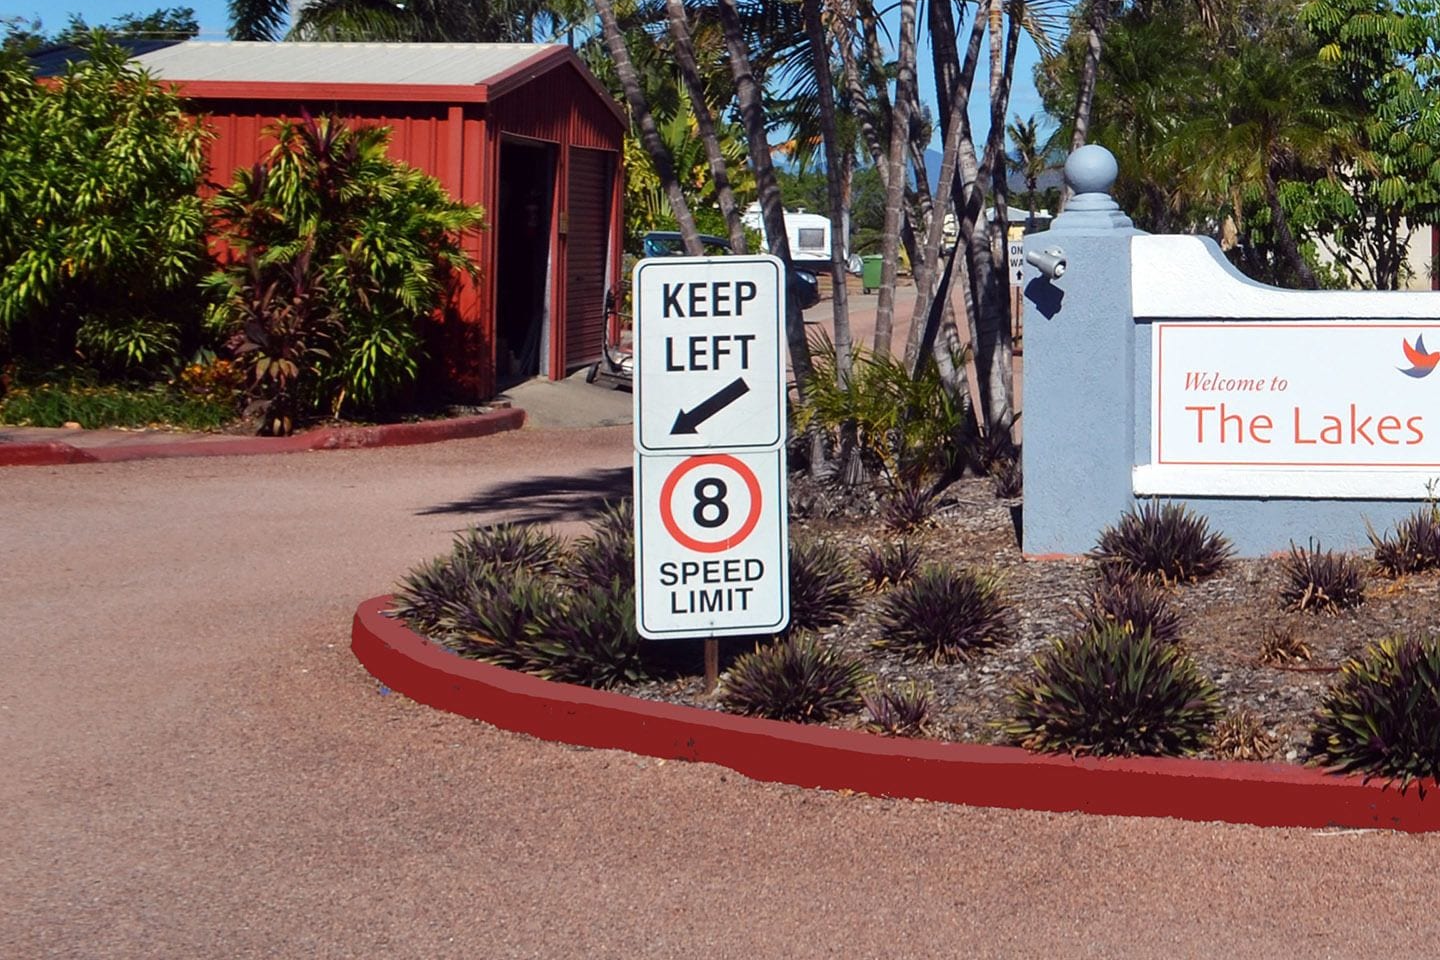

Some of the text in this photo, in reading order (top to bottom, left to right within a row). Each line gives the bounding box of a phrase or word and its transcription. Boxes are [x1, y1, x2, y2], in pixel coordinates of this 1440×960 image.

[1010, 245, 1024, 255] ON
[662, 280, 758, 319] KEEP
[665, 334, 756, 373] LEFT
[1184, 371, 1289, 392] Welcome to
[1184, 402, 1274, 445] The
[1293, 402, 1425, 447] Lakes
[692, 477, 730, 529] 8
[659, 558, 765, 587] SPEED
[670, 587, 754, 615] LIMIT
